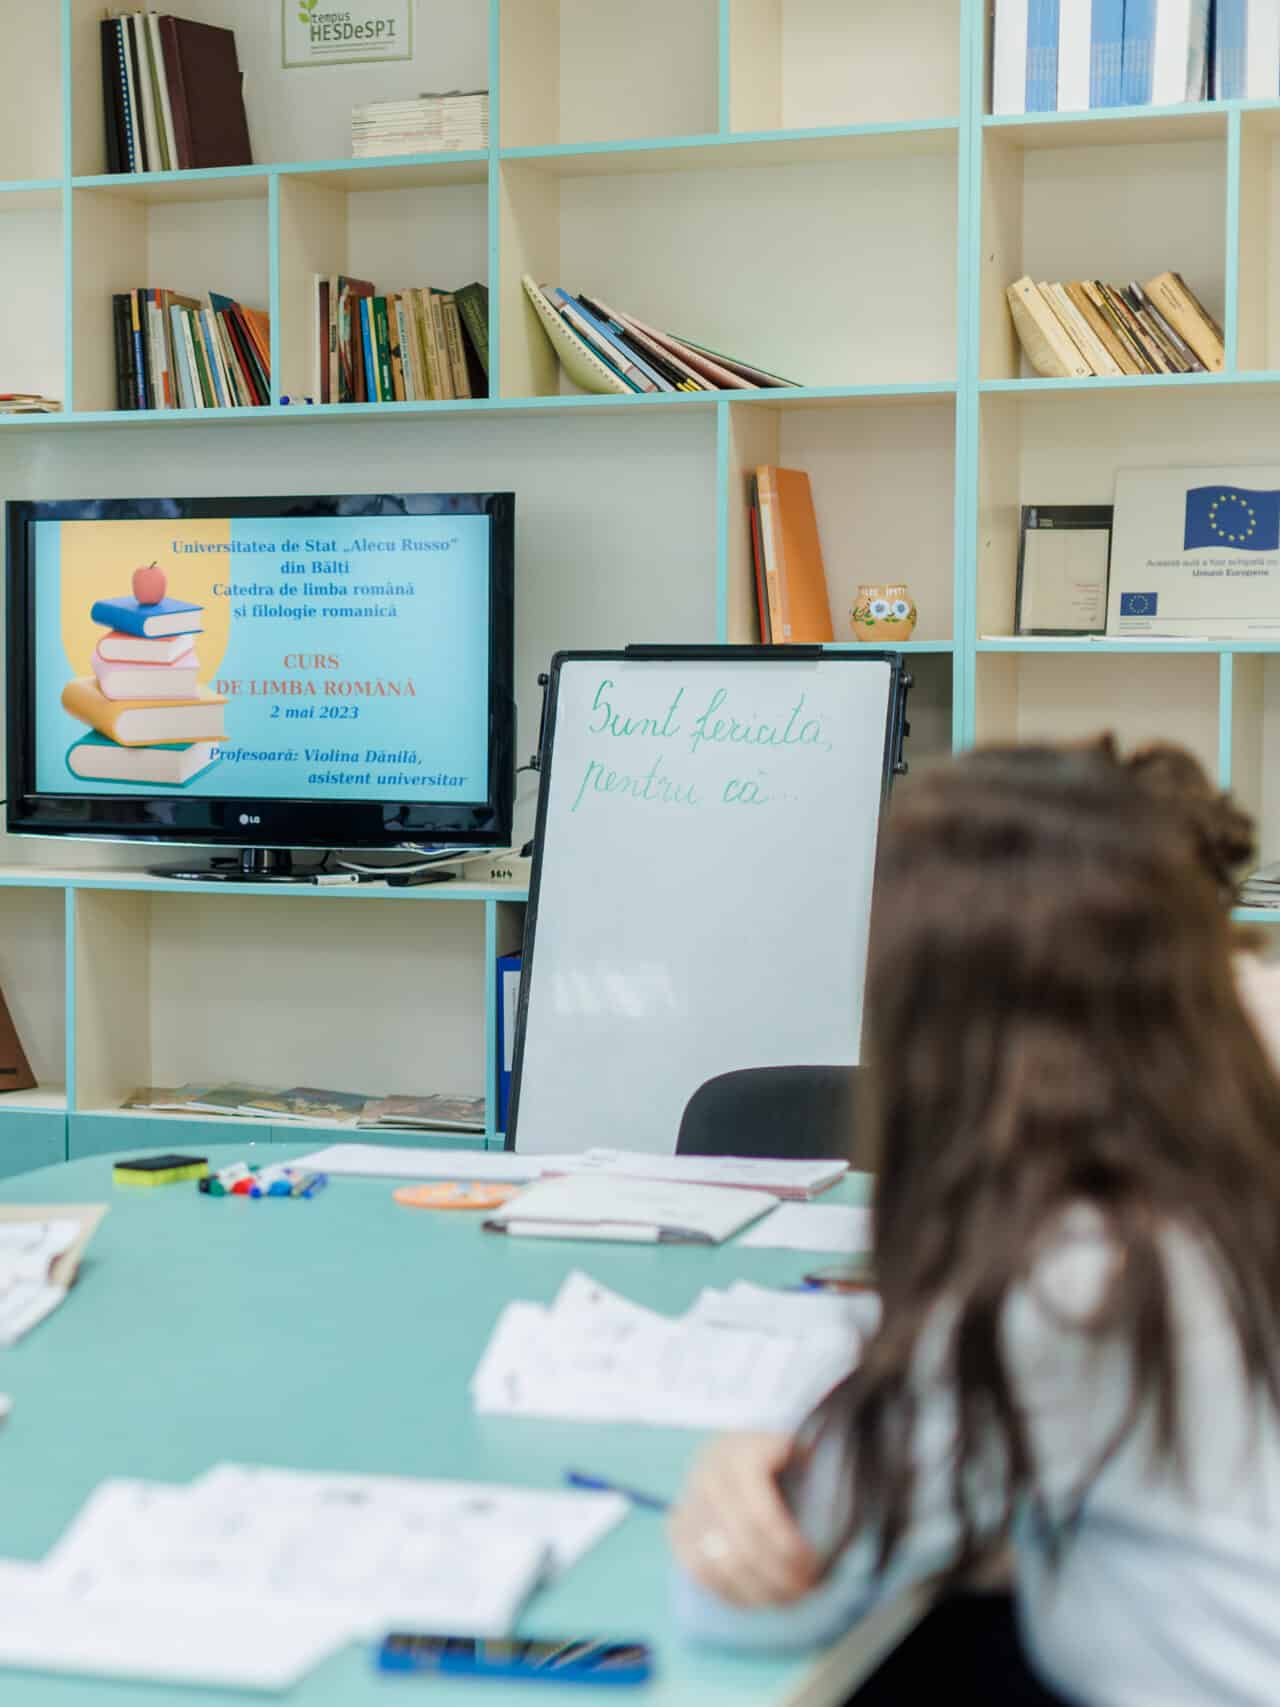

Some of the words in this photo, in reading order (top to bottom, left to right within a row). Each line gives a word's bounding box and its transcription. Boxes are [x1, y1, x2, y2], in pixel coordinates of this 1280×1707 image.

[312, 12, 351, 24] tempus
[310, 19, 396, 42] HESDeSPI
[172, 540, 276, 554] Universitatea
[281, 540, 300, 552] de
[305, 539, 337, 552] Stat
[280, 561, 305, 574] din
[212, 583, 274, 597] Catedra
[279, 582, 298, 596] de
[303, 582, 348, 596] limba
[252, 605, 317, 621] filologie
[322, 604, 397, 618] romanică
[283, 654, 340, 670] CURS
[216, 680, 242, 696] DE
[250, 680, 317, 696] LIMBA
[270, 706, 280, 719] 2
[285, 706, 315, 719] mai
[319, 705, 359, 720] 2023
[589, 679, 685, 738] Sunt
[209, 747, 299, 764] Profesoară:
[305, 749, 360, 763] Violina
[307, 771, 371, 785] asistent
[377, 772, 468, 787] universitar
[571, 753, 697, 813] pentru
